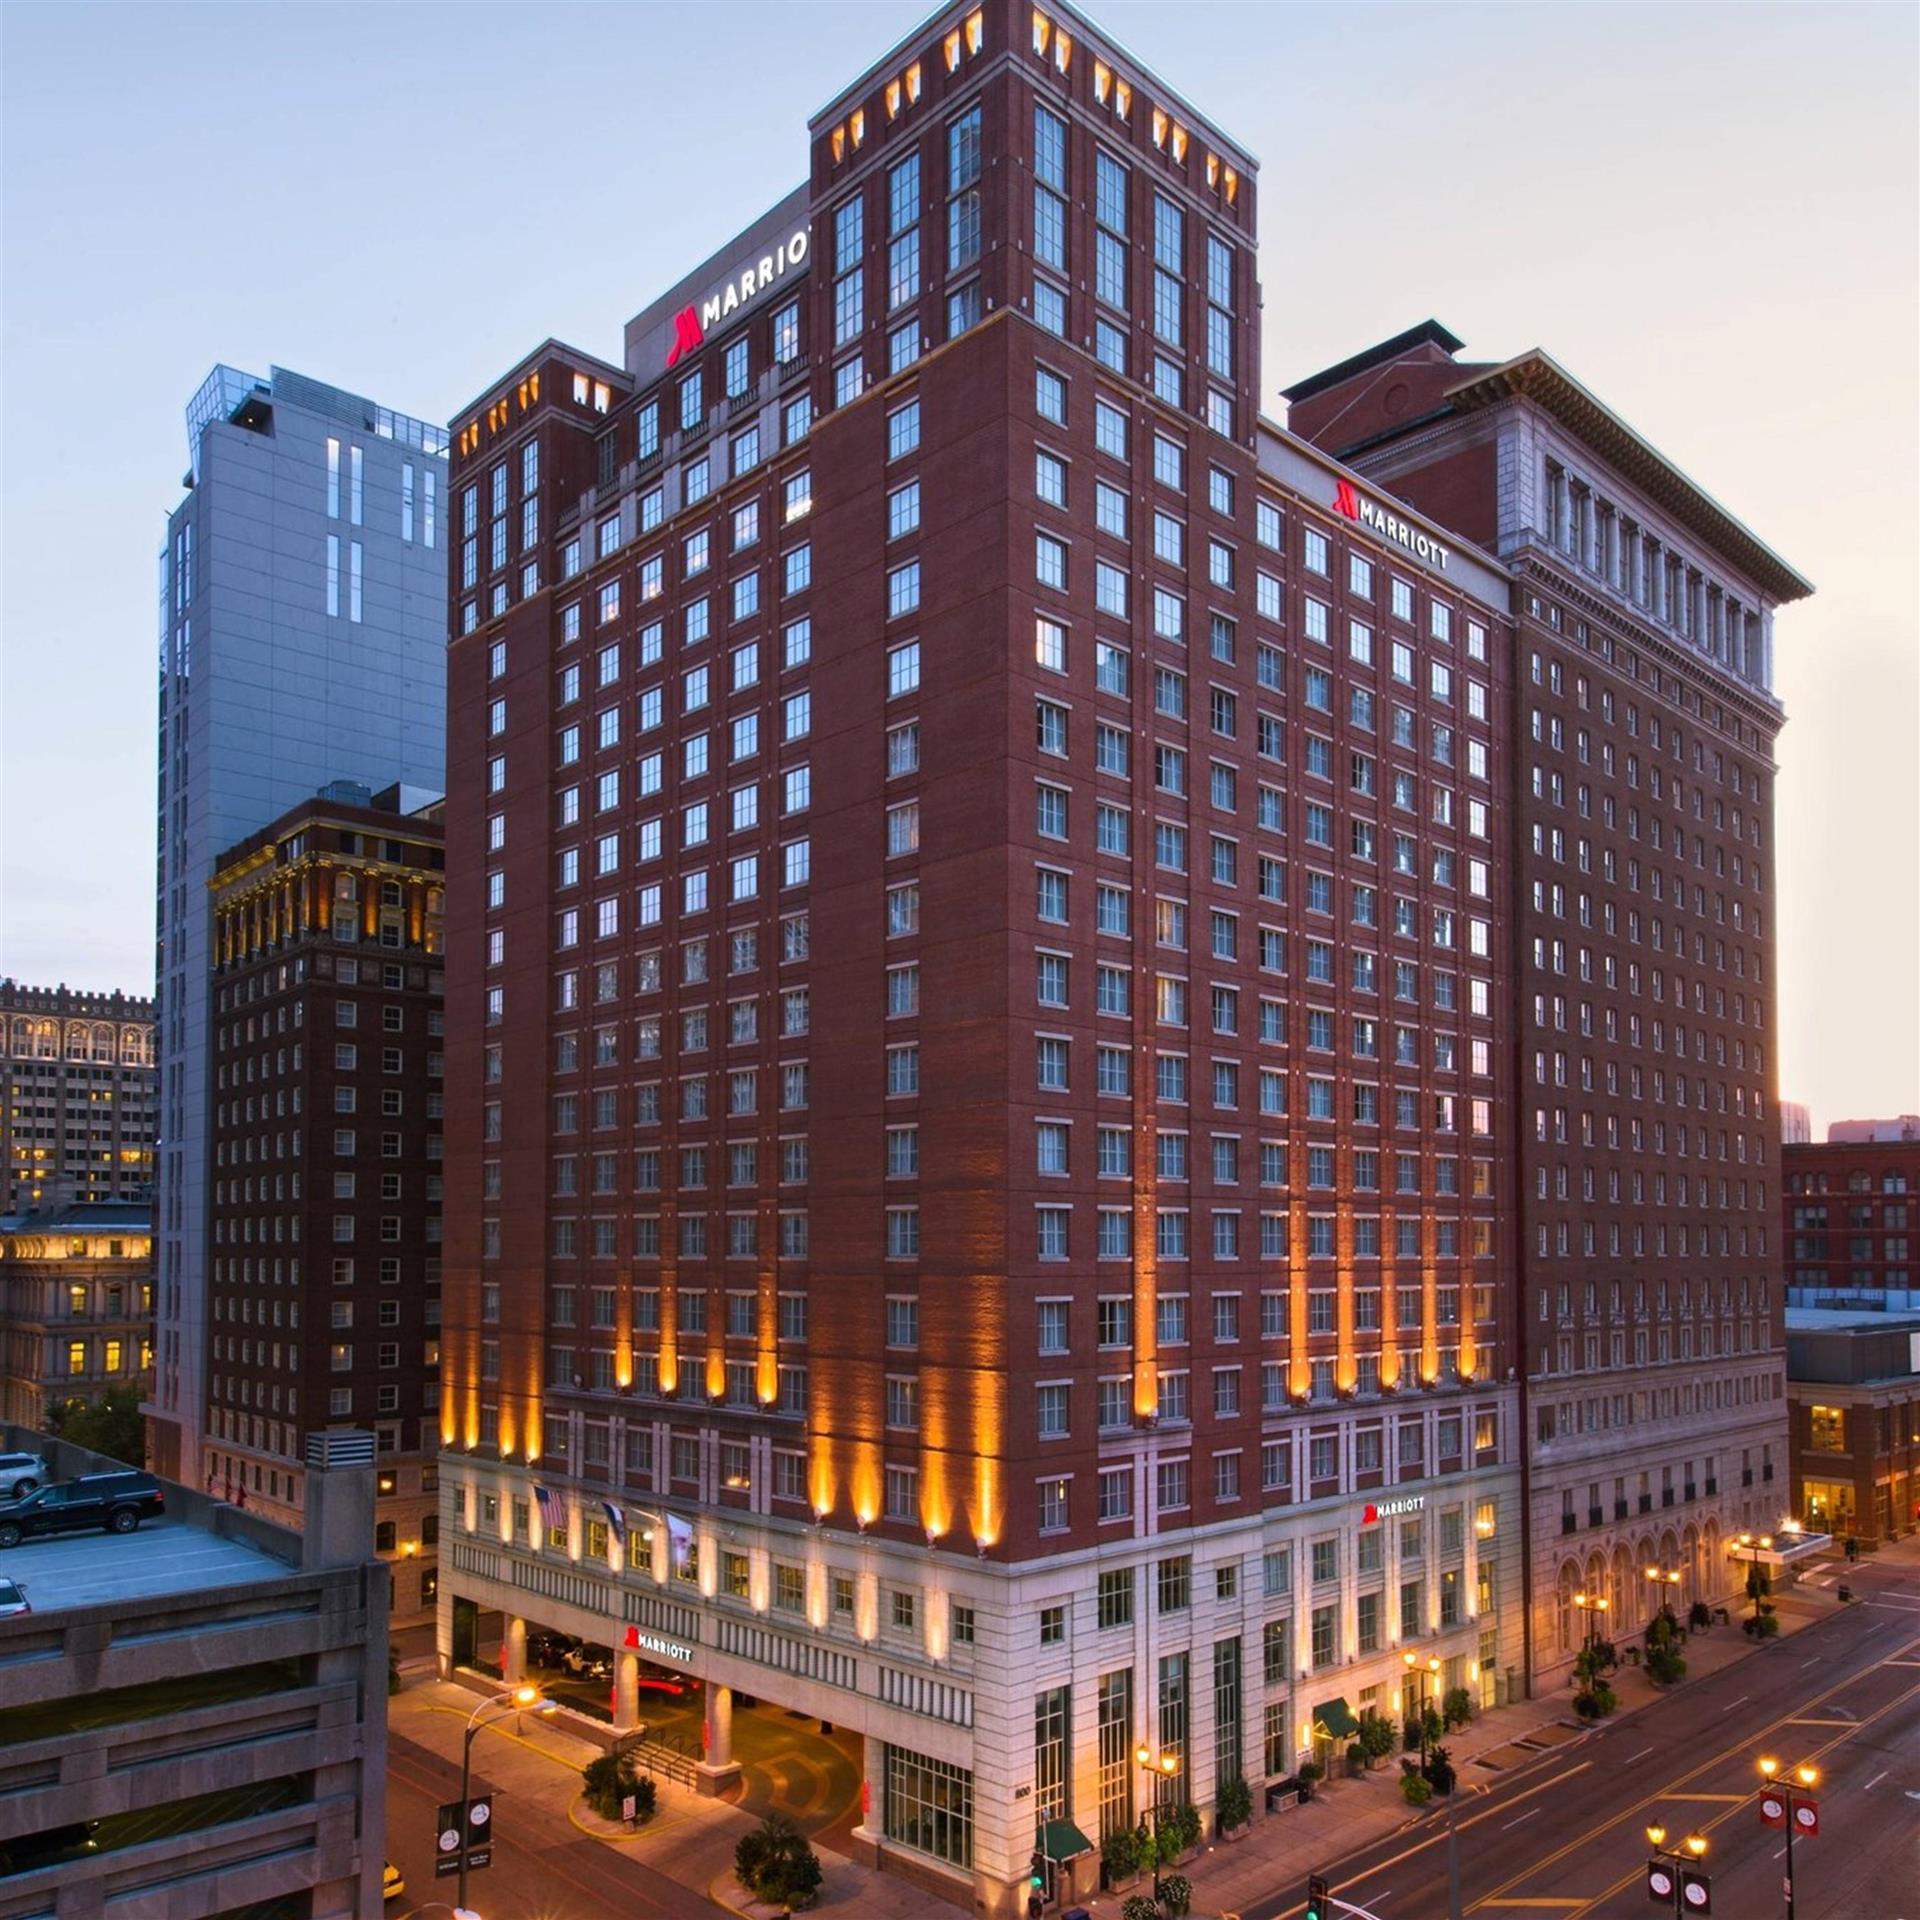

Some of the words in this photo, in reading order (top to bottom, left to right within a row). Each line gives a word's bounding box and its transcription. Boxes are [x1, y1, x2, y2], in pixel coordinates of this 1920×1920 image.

[702, 224, 813, 332] MARRIO
[1359, 498, 1449, 569] MARRIOTT
[1377, 1496, 1425, 1518] MARRIOTT
[638, 1633, 692, 1662] MARRIOTT
